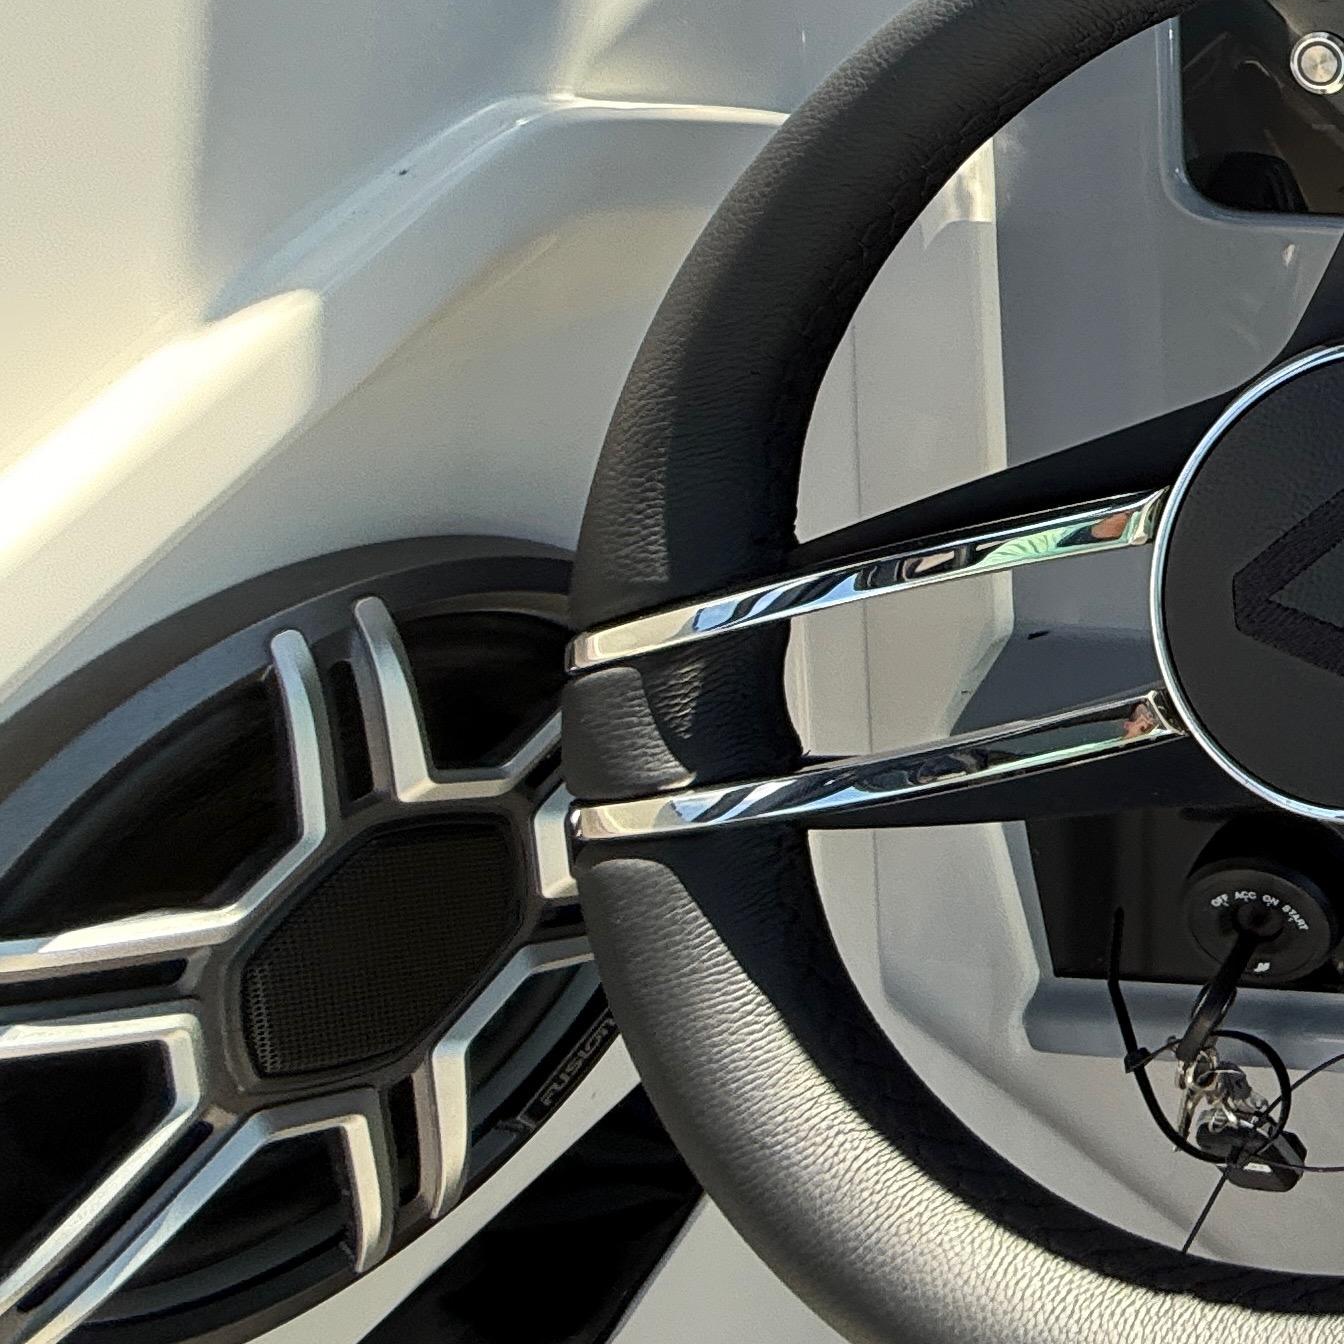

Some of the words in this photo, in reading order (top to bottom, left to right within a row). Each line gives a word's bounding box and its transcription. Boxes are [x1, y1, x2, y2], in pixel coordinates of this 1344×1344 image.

[1211, 894, 1228, 906] OFF
[1234, 891, 1256, 900] ACC
[1282, 904, 1308, 930] START
